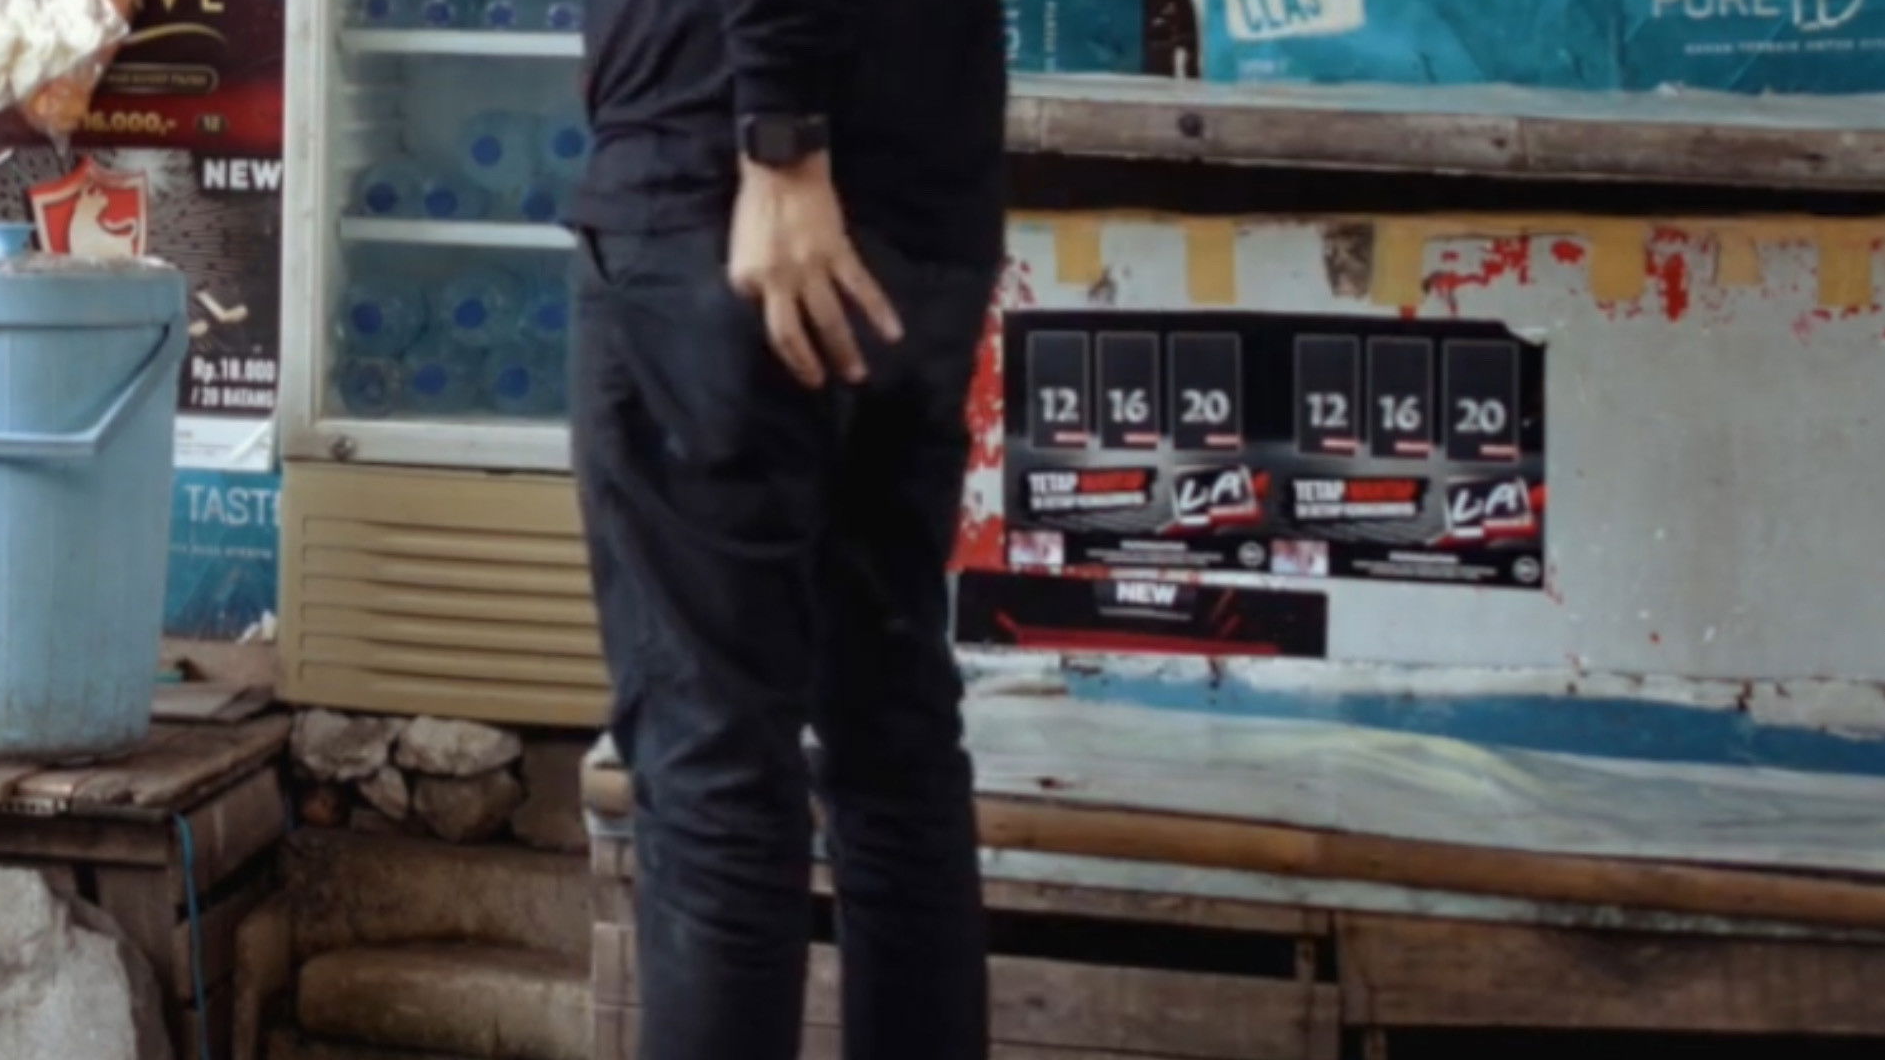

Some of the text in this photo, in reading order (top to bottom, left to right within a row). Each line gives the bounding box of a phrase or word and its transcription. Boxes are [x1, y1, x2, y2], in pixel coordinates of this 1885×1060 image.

[203, 159, 283, 190] NEW
[1040, 388, 1230, 423] 12 16 20
[1306, 393, 1506, 433] 12 16 20
[1179, 468, 1244, 510] LA
[1452, 485, 1518, 523] LA
[1116, 580, 1178, 605] NEW
